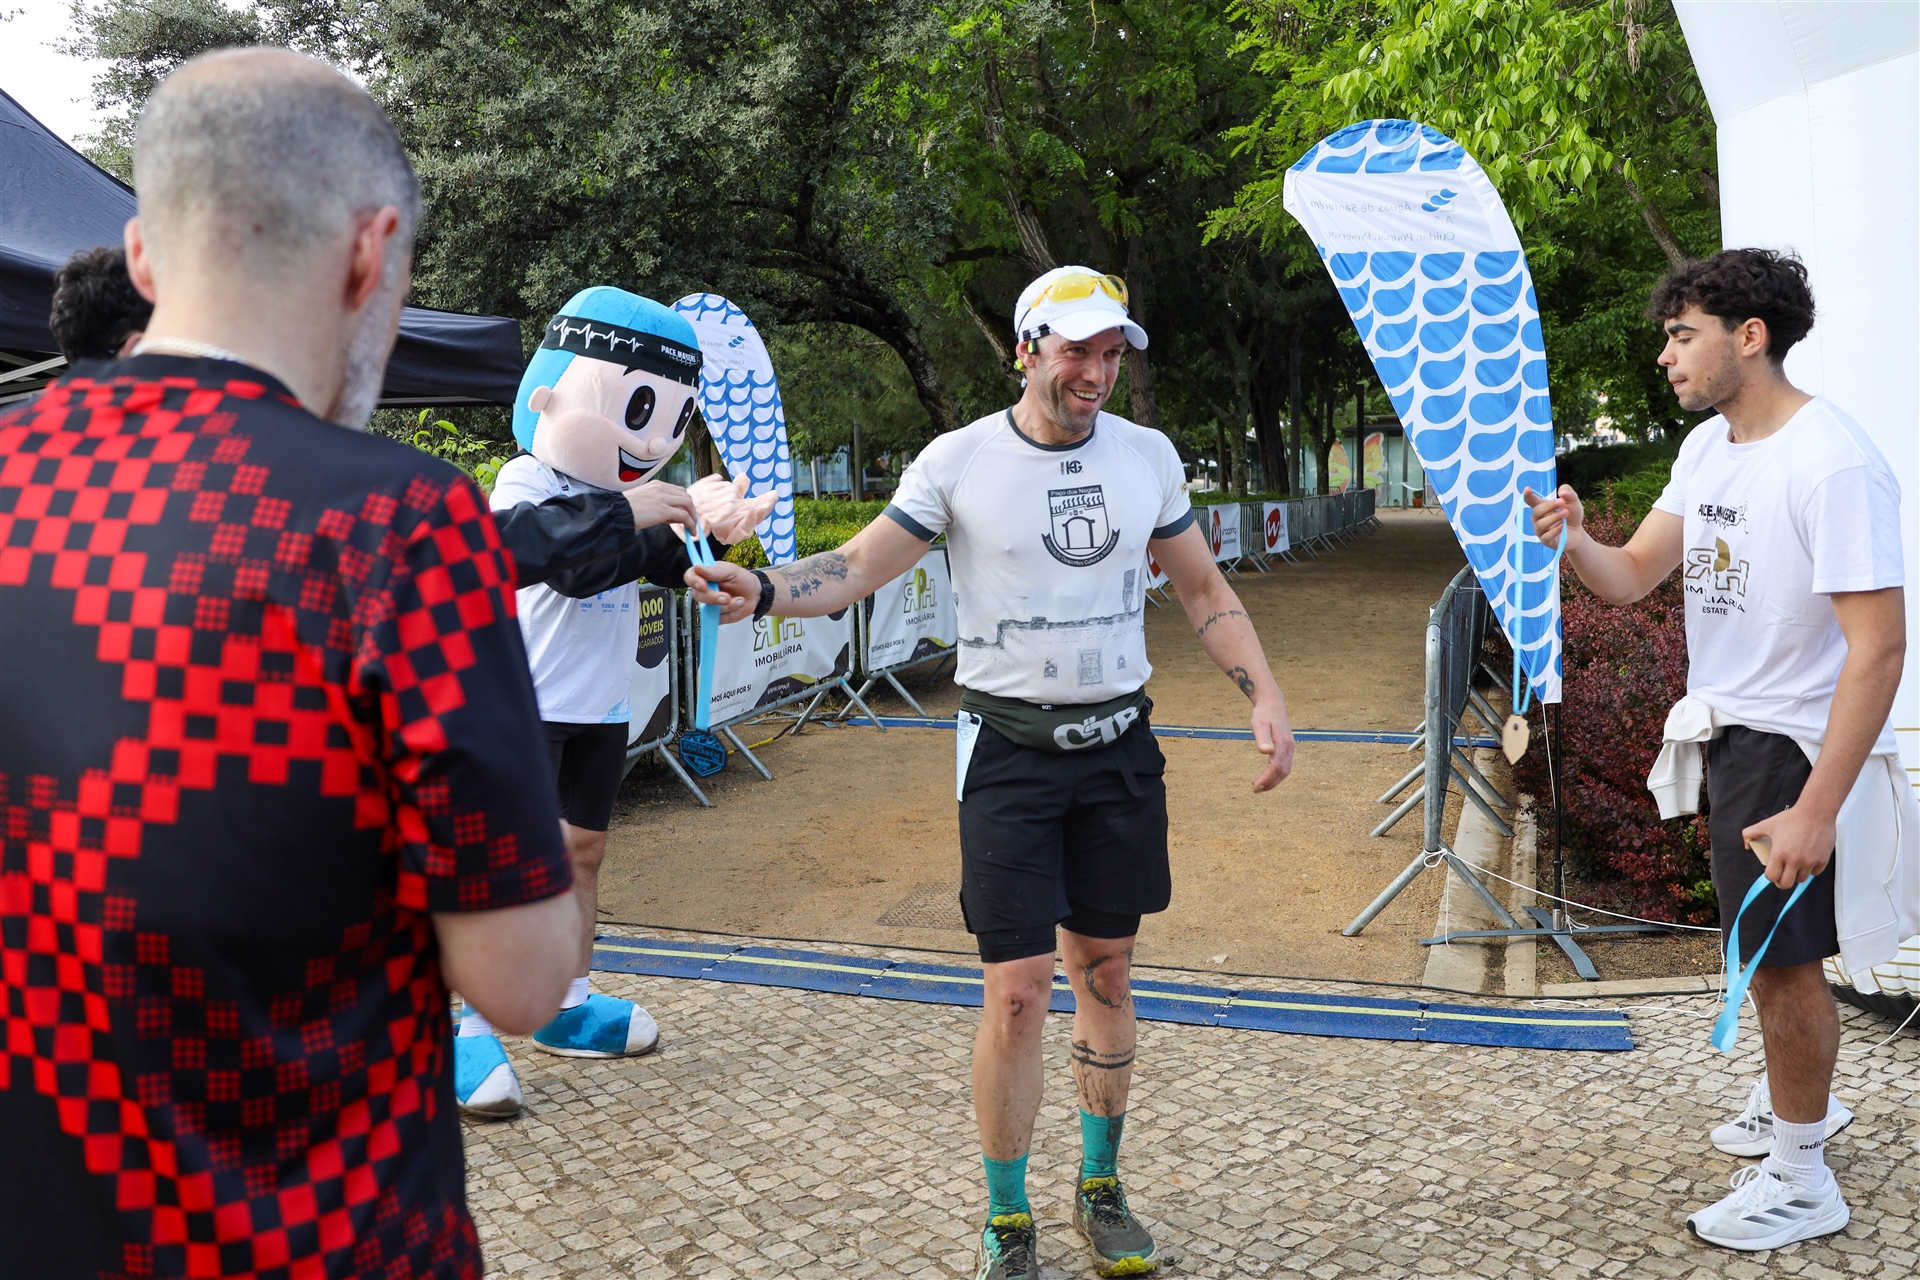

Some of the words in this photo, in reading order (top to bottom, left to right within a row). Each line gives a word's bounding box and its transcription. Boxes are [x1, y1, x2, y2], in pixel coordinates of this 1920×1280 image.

[1079, 487, 1100, 496] Negros
[1702, 606, 1728, 615] ESTATE
[755, 643, 803, 667] IMOBILIÁRIA
[723, 691, 735, 700] AQUI
[736, 686, 747, 696] POR
